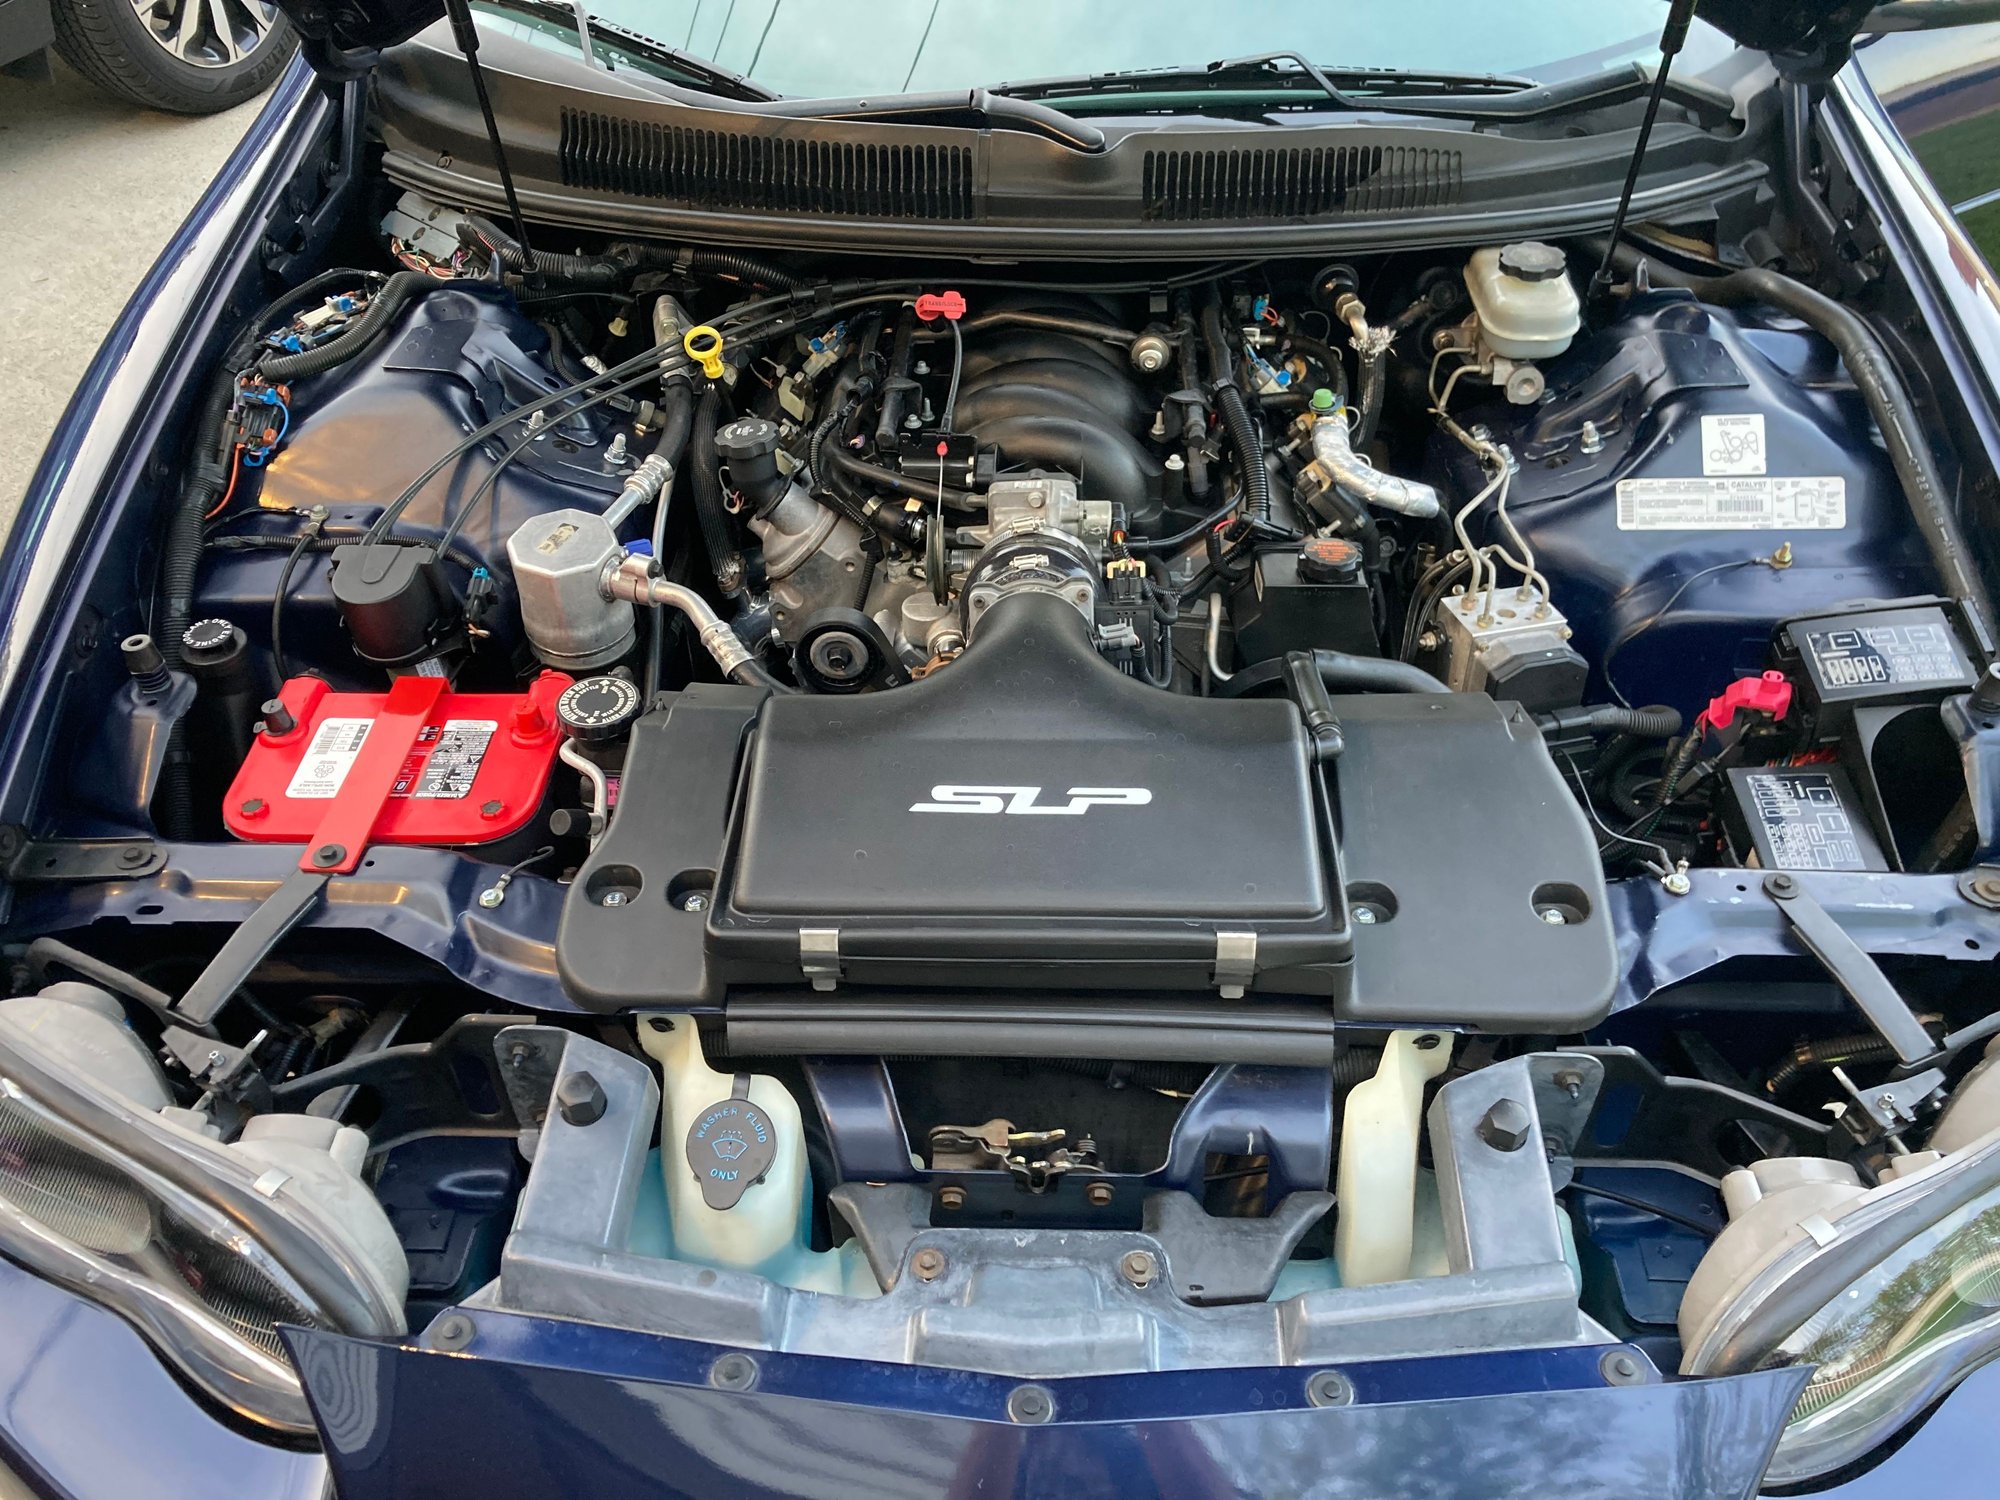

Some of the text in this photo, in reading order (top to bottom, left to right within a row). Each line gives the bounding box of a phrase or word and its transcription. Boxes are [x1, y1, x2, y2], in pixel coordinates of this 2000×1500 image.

[211, 618, 233, 629] ONLY
[573, 681, 590, 691] HOT
[908, 784, 1153, 815] SLP
[695, 1107, 767, 1181] WASHER FLUID ONLY
